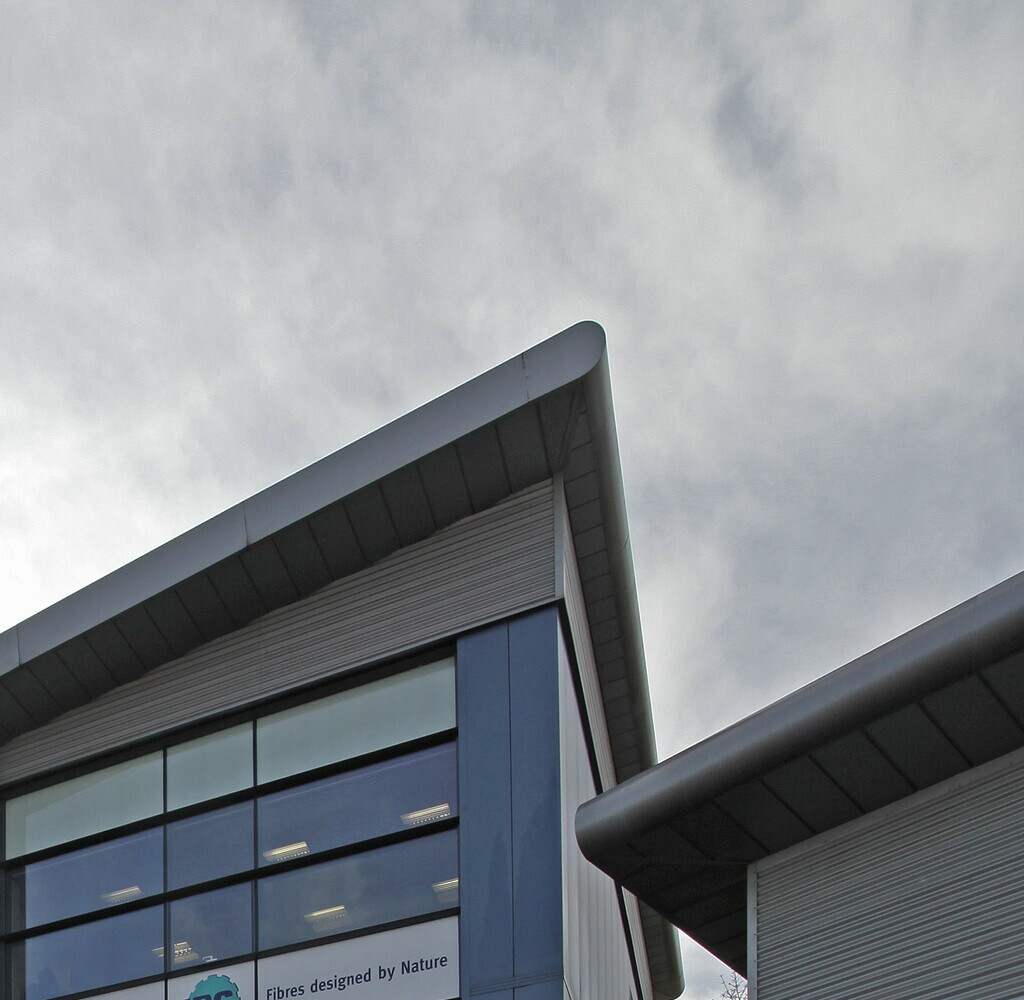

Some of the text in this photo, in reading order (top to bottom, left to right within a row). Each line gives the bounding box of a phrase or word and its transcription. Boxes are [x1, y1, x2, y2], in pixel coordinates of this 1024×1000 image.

[310, 968, 371, 991] designed
[378, 966, 396, 981] by
[401, 956, 448, 975] Nature
